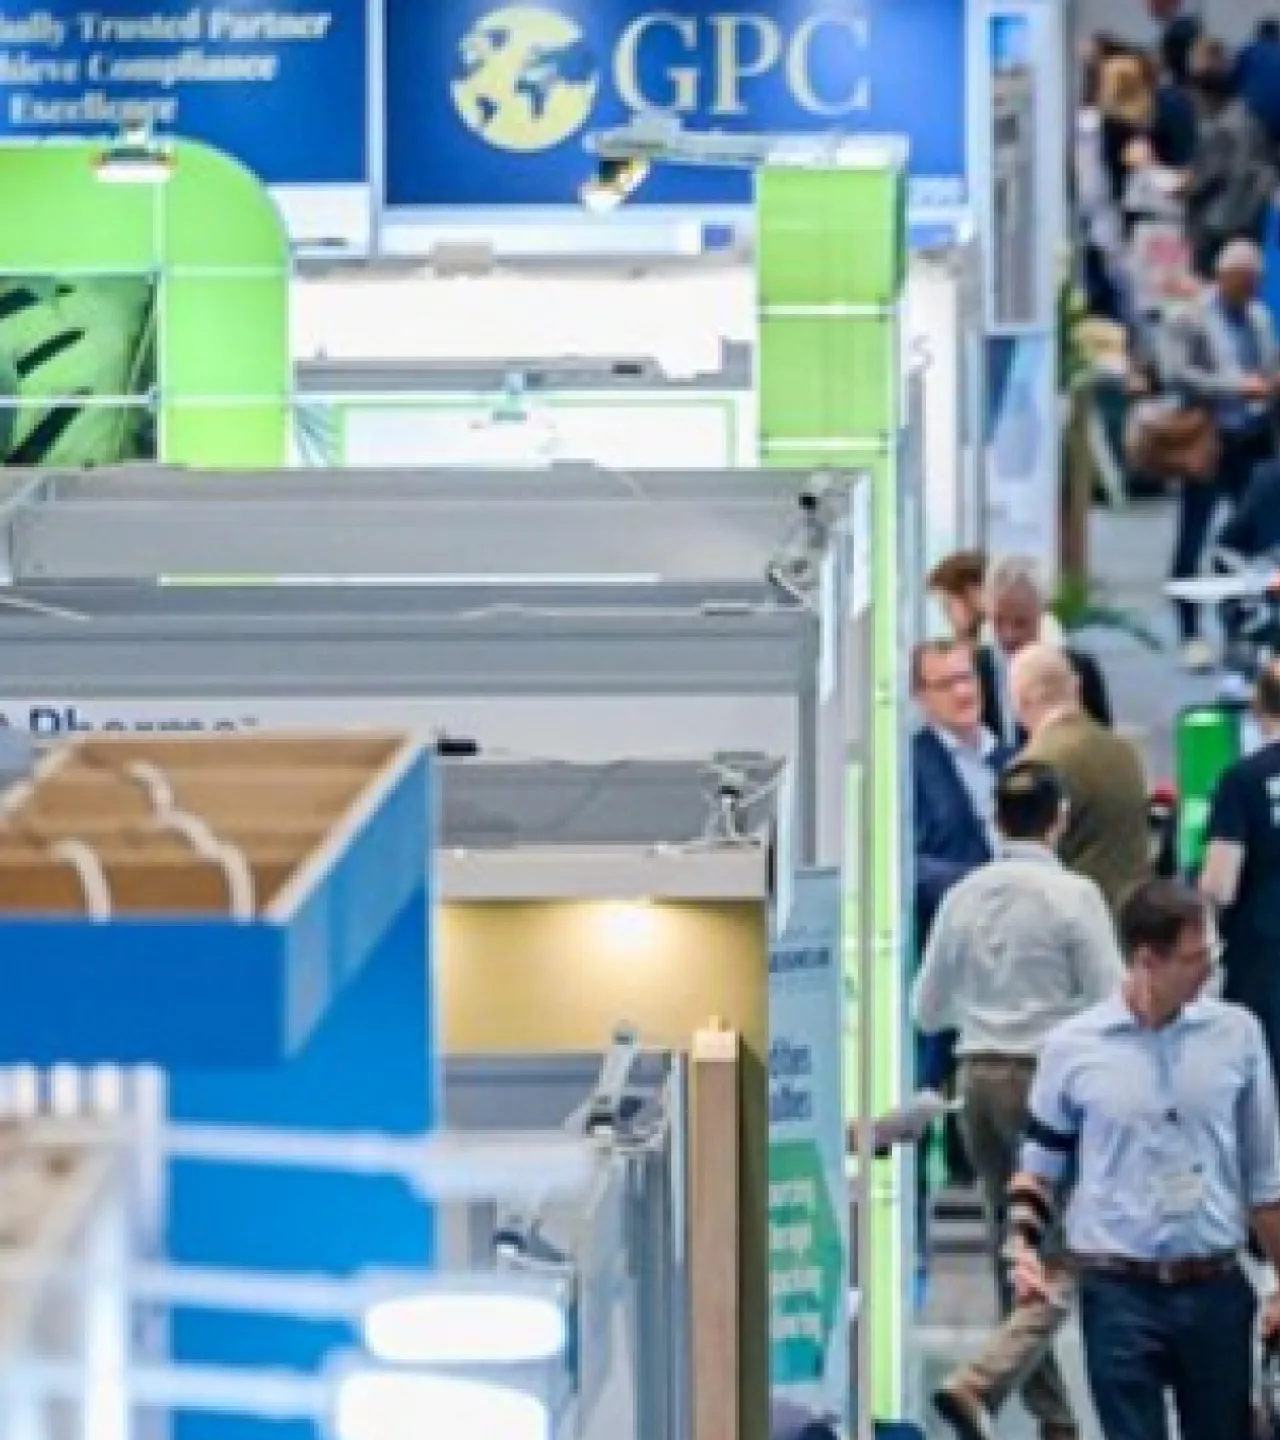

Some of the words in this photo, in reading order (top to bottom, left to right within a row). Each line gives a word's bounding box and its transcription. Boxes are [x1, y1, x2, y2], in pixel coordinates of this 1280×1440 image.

[208, 11, 332, 40] Partner
[87, 48, 281, 88] Compliance
[612, 11, 872, 116] GPC
